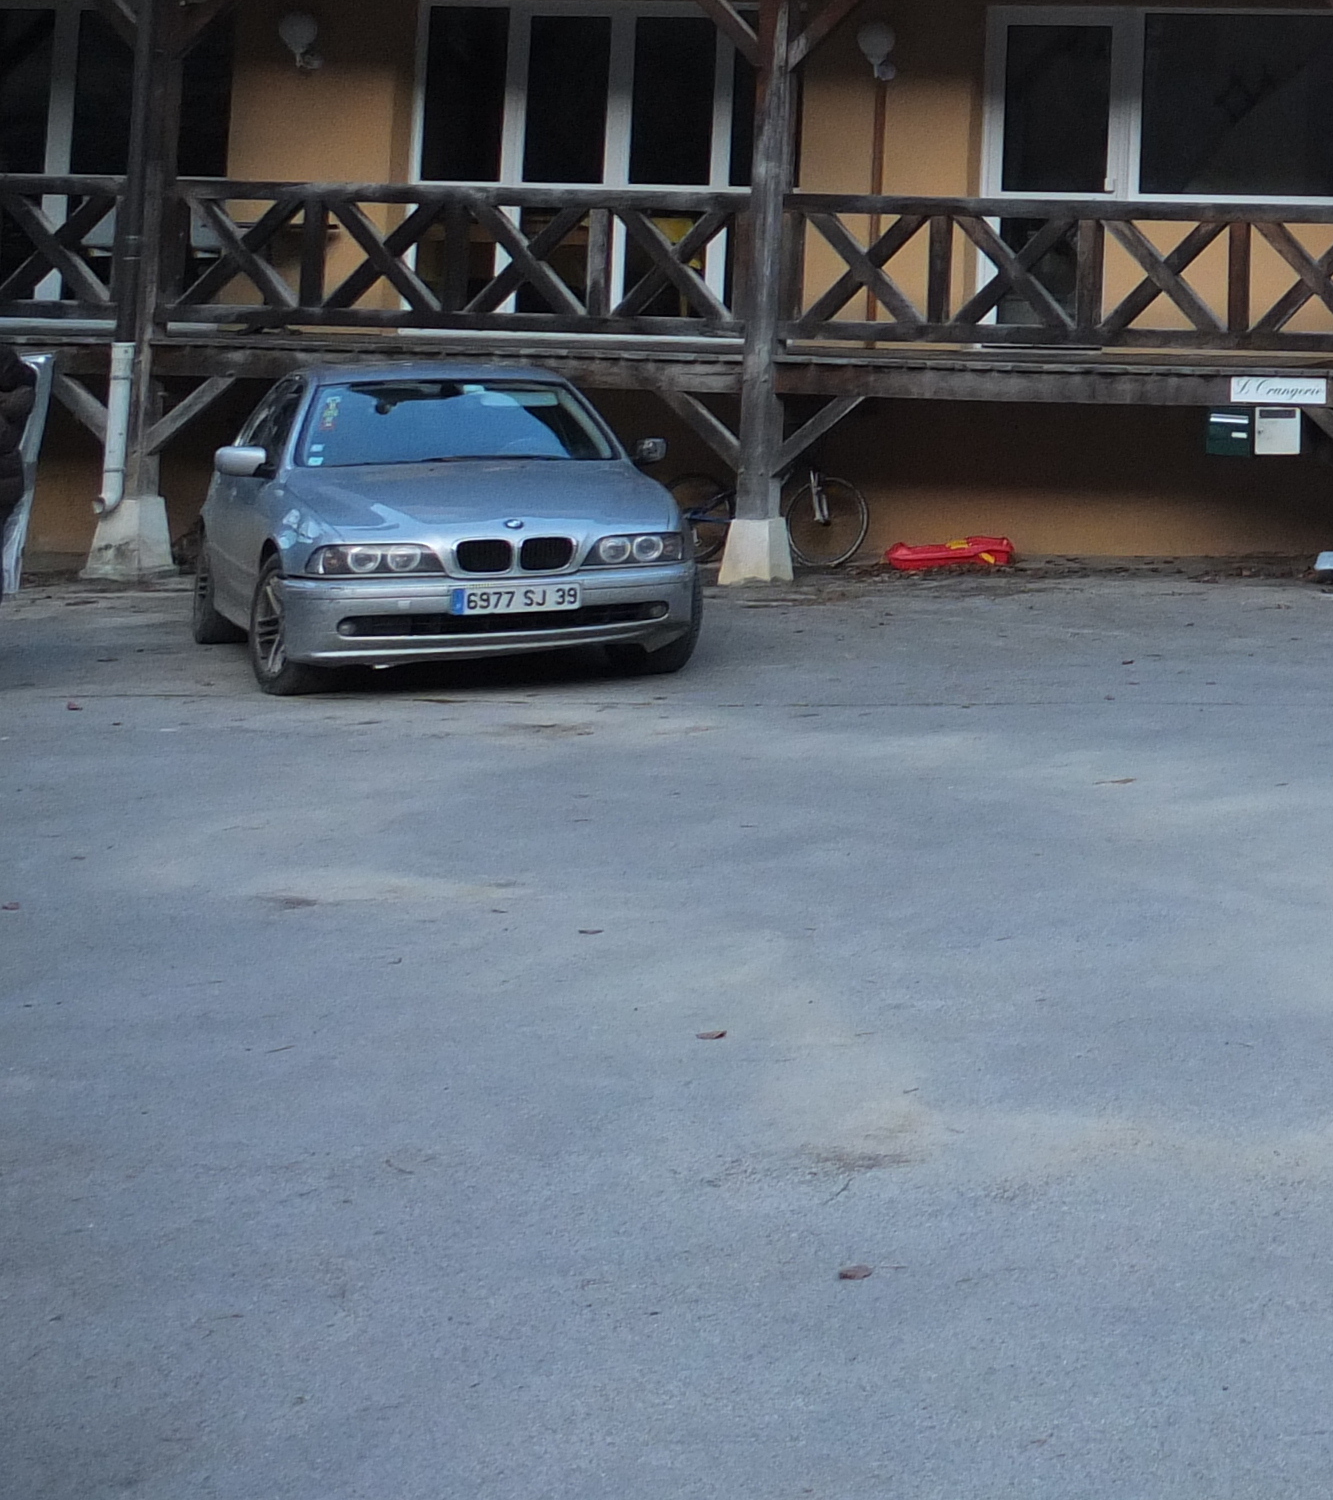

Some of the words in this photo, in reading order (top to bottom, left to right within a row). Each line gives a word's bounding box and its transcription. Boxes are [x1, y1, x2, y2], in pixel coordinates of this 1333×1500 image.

[466, 591, 515, 610] 6977
[523, 589, 547, 607] SJ
[554, 587, 577, 605] 39
